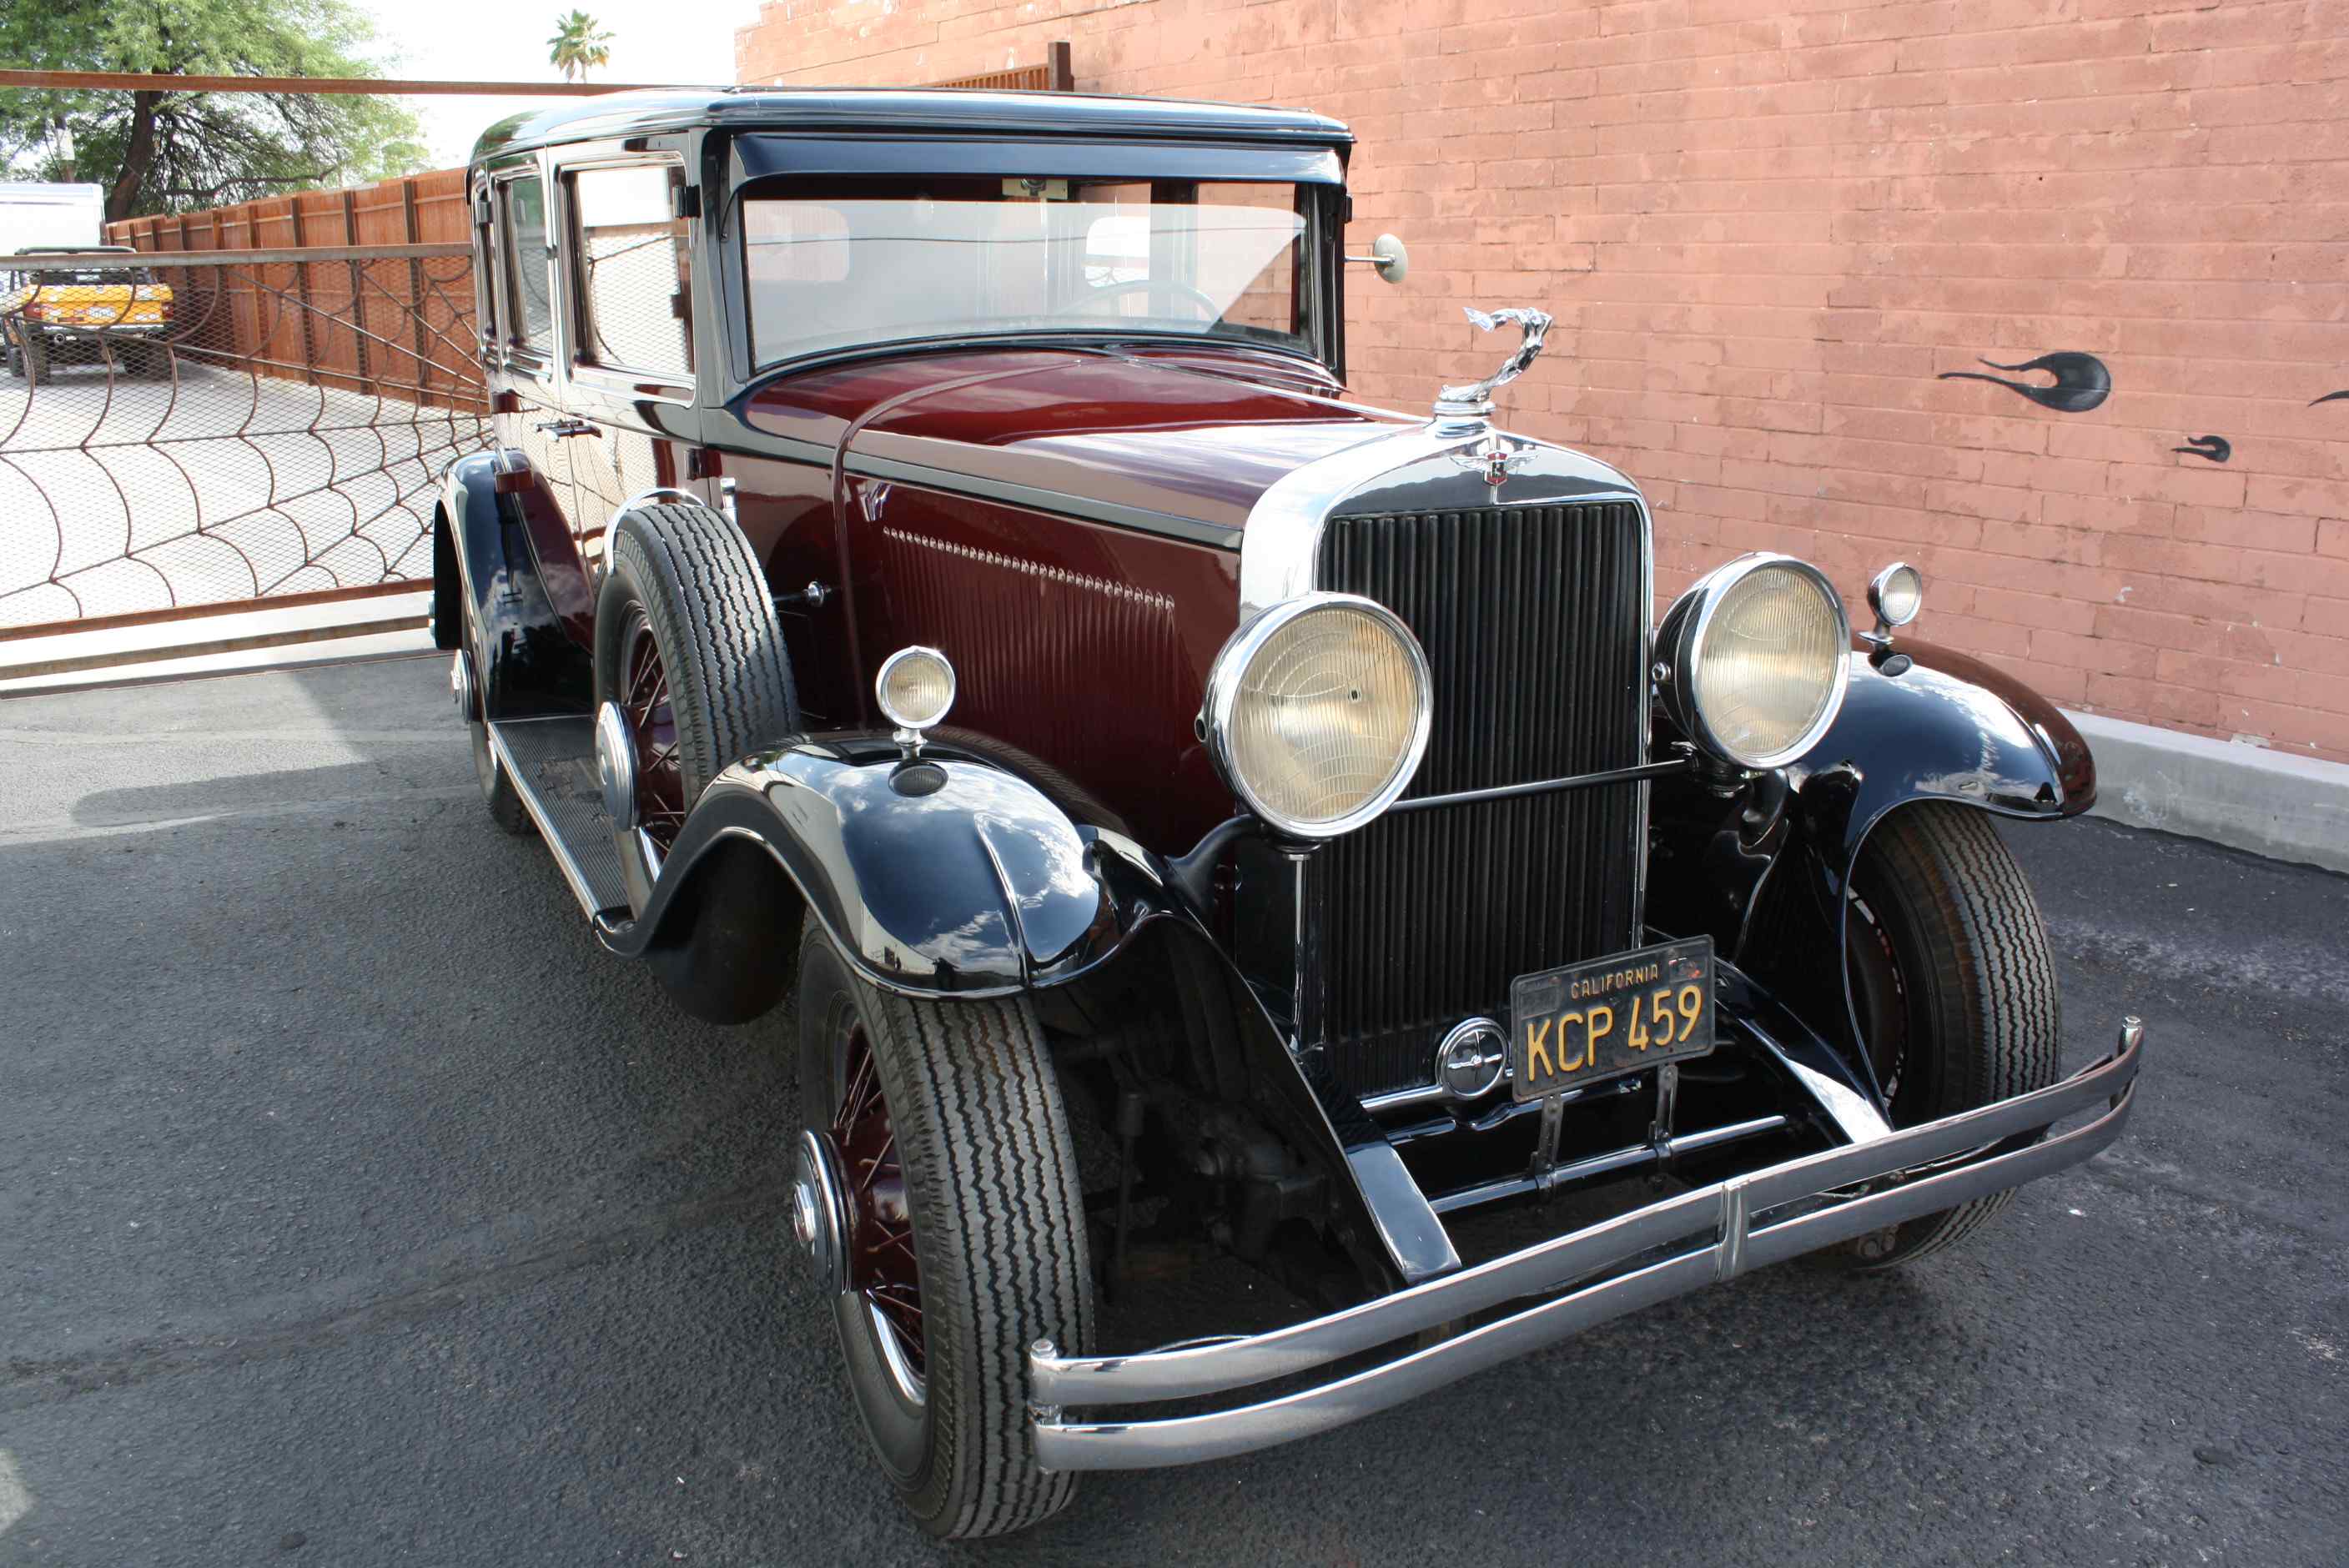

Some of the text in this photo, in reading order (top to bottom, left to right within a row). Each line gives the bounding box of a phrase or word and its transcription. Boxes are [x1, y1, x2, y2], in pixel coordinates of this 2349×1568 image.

[1571, 963, 1659, 1000] CALIFORNIA
[1527, 984, 1703, 1082] KCP 459
